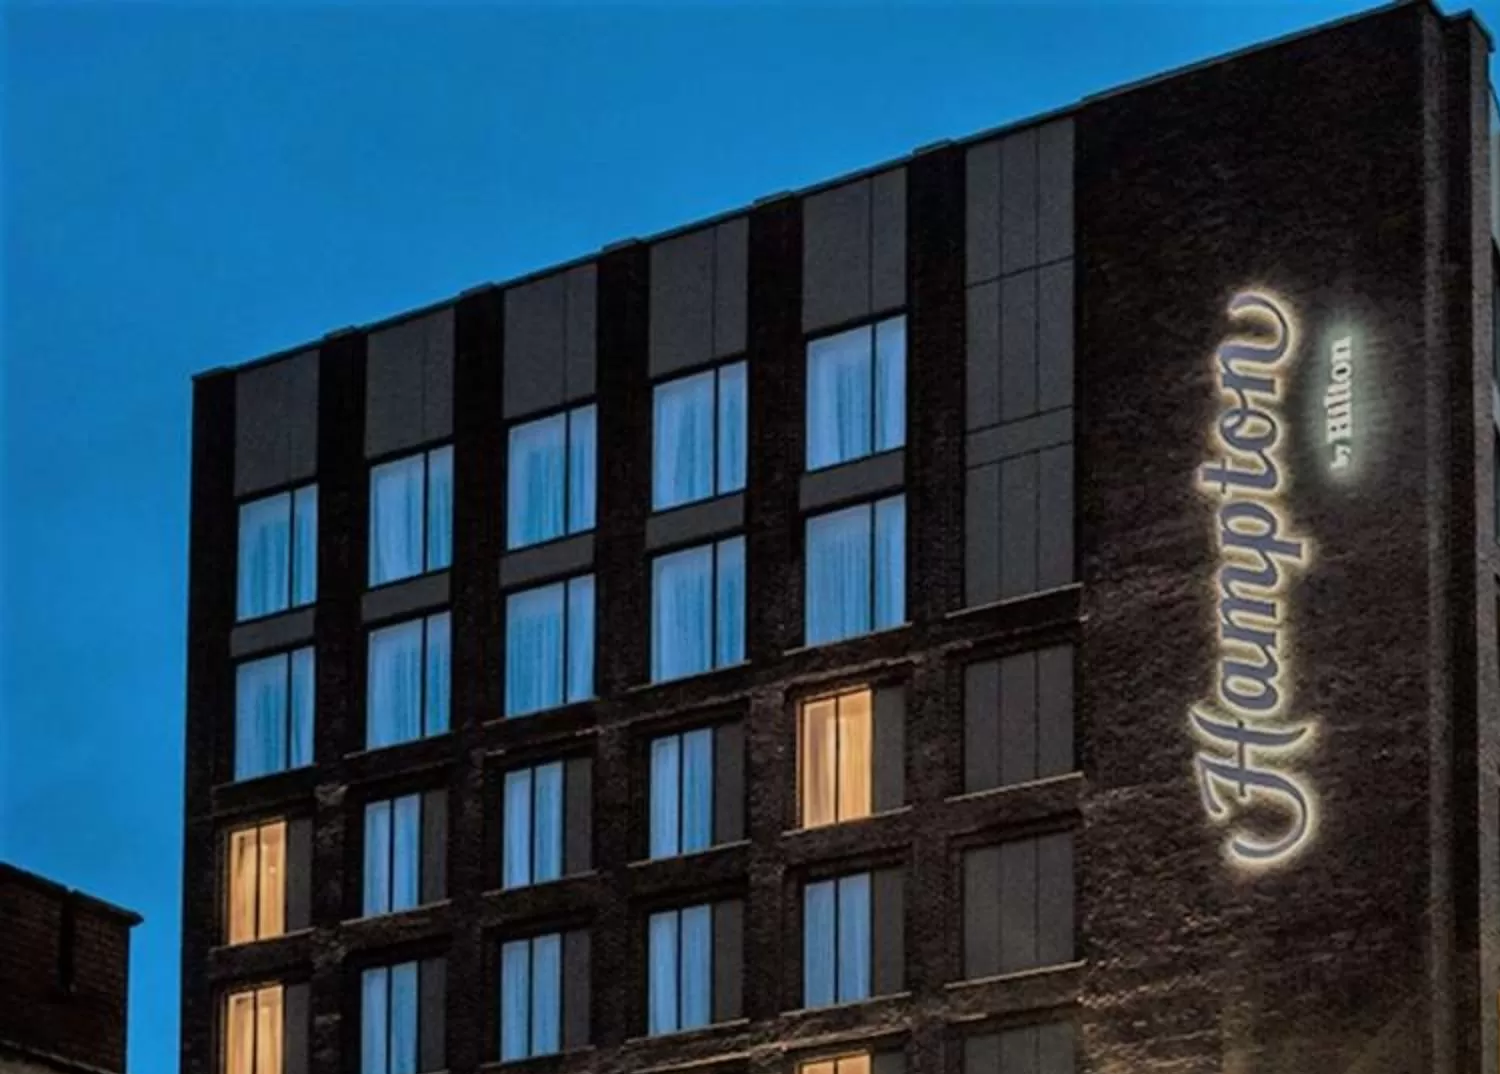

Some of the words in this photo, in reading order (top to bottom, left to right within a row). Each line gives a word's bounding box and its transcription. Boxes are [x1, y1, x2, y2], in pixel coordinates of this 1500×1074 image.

[1324, 335, 1353, 443] Hilton
[1330, 443, 1353, 471] by
[1190, 290, 1313, 860] Hampton
